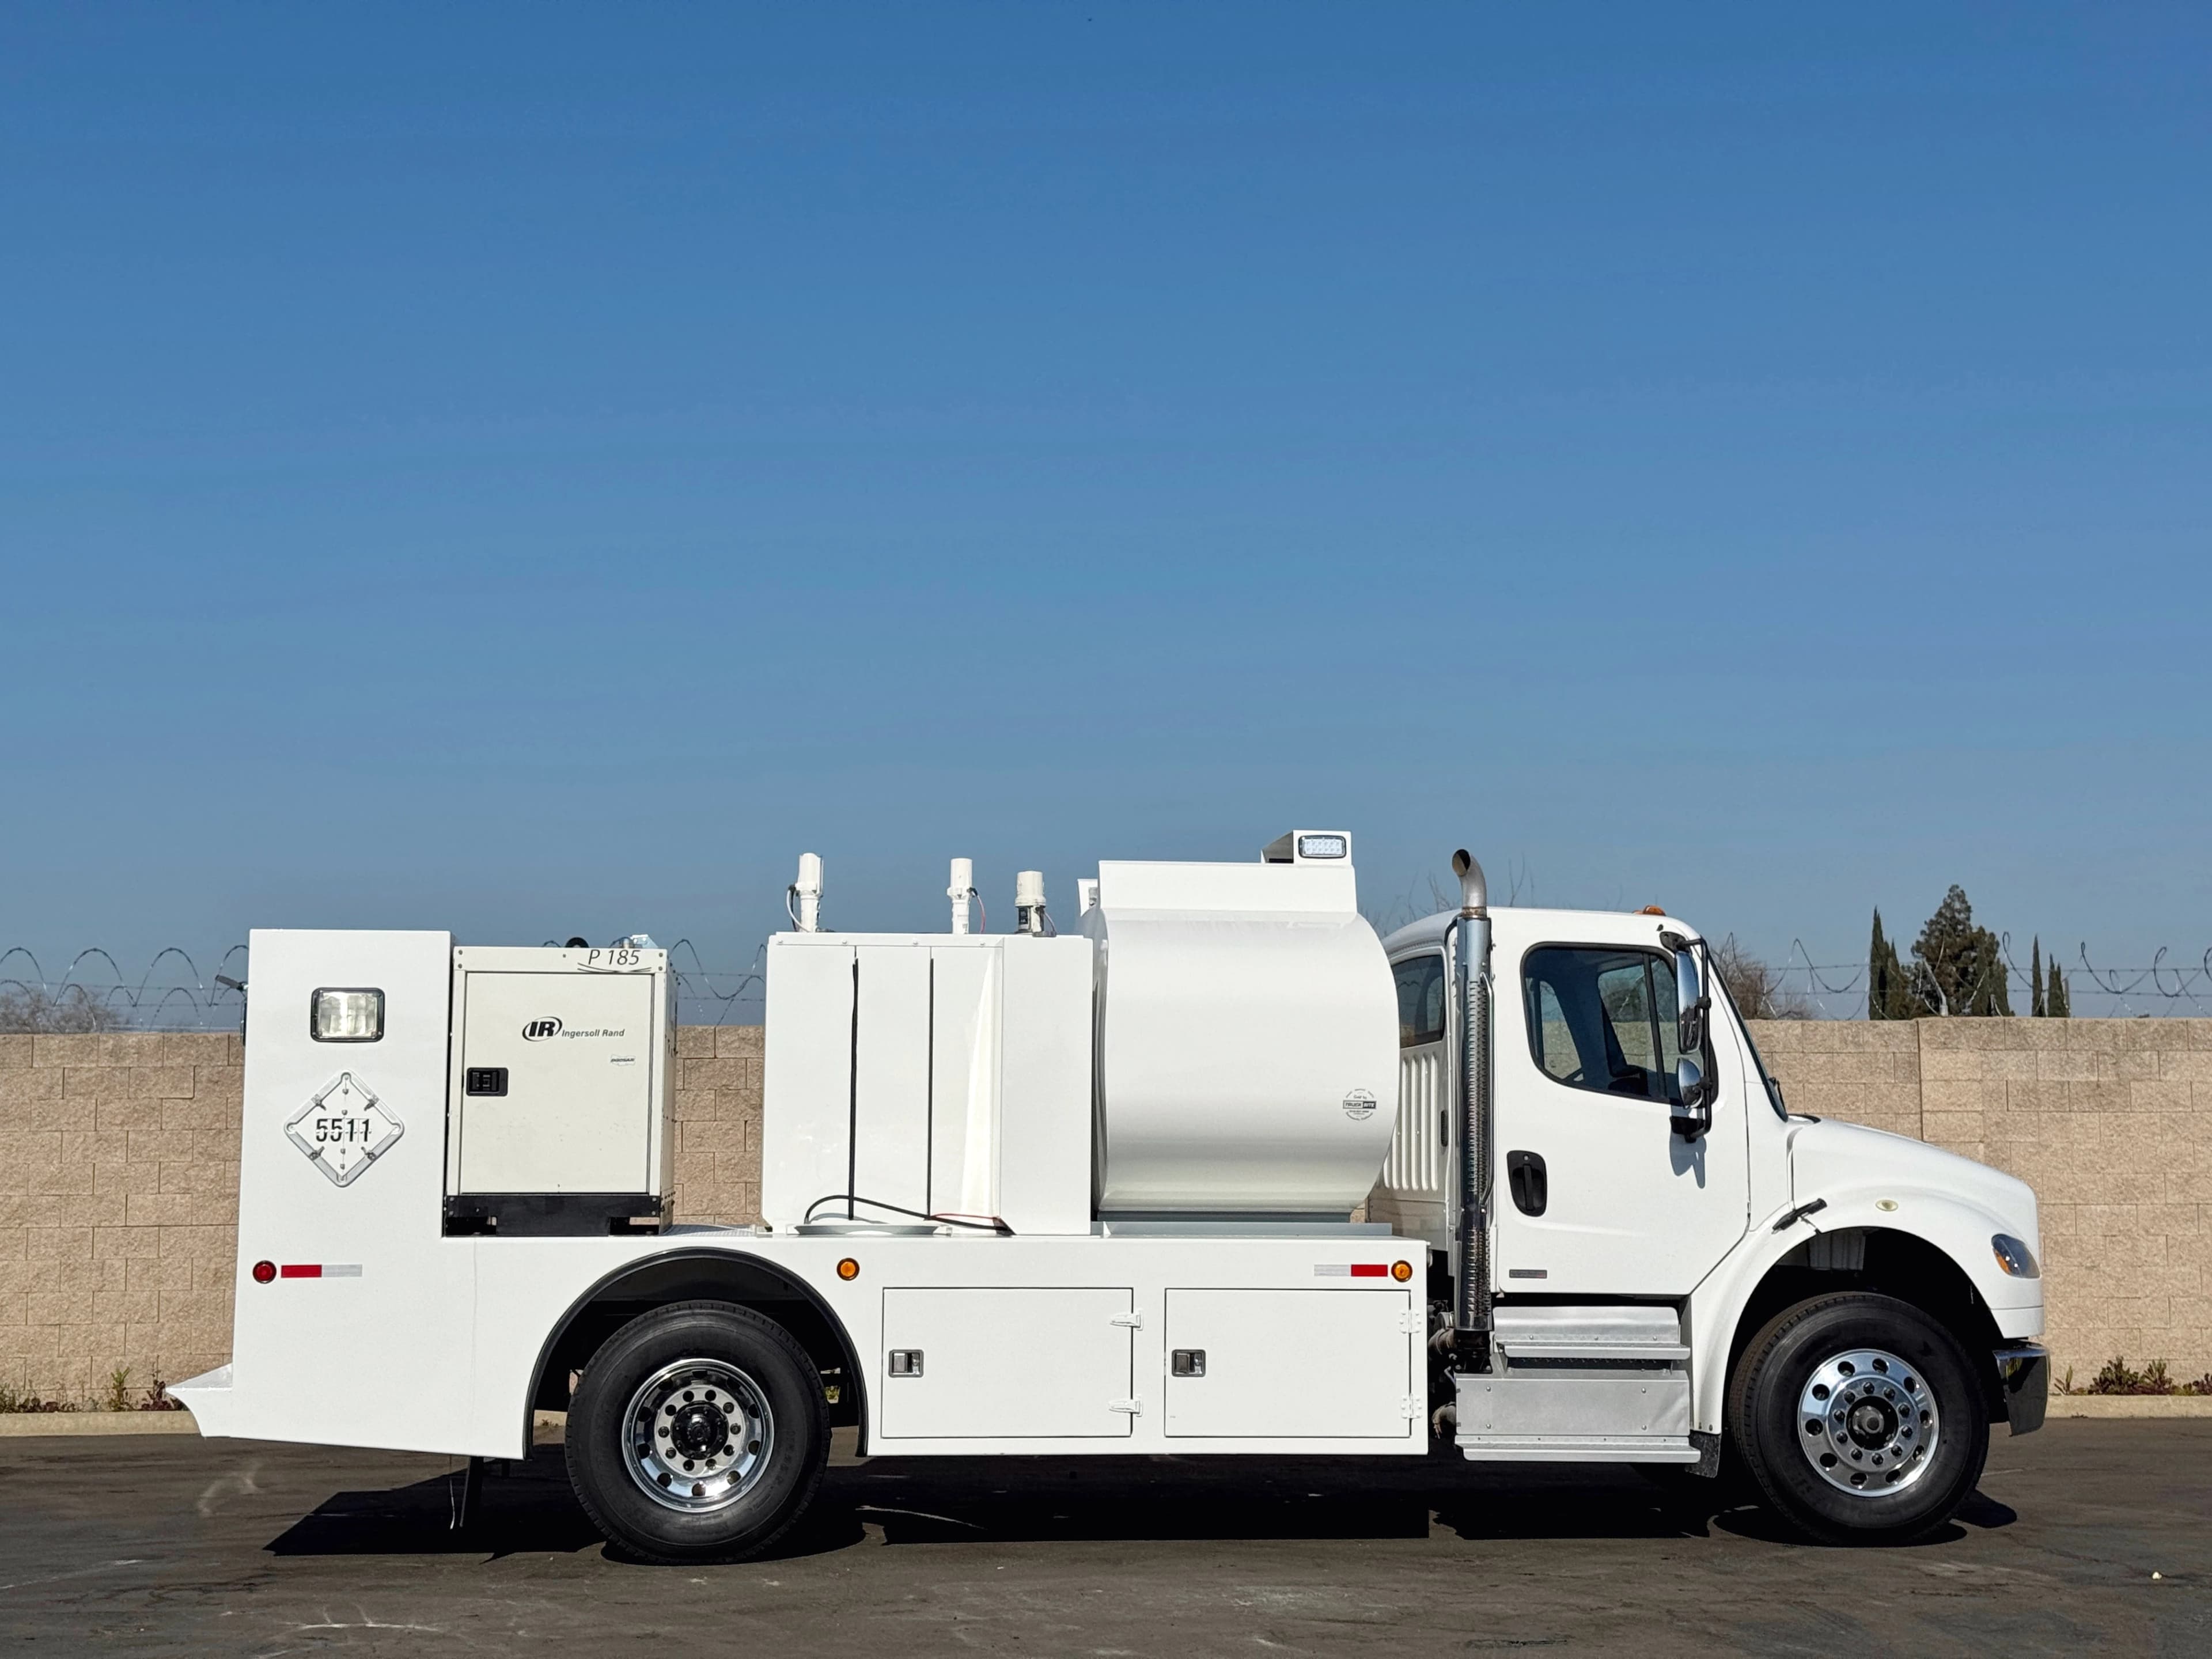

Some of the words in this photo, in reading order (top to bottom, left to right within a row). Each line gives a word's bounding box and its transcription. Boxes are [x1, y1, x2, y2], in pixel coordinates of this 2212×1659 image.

[588, 949, 600, 965] P
[609, 950, 641, 965] 185
[528, 1021, 556, 1037] IR
[562, 1029, 600, 1039] Ingersoll
[602, 1029, 625, 1037] Rand
[316, 1119, 369, 1142] 5511
